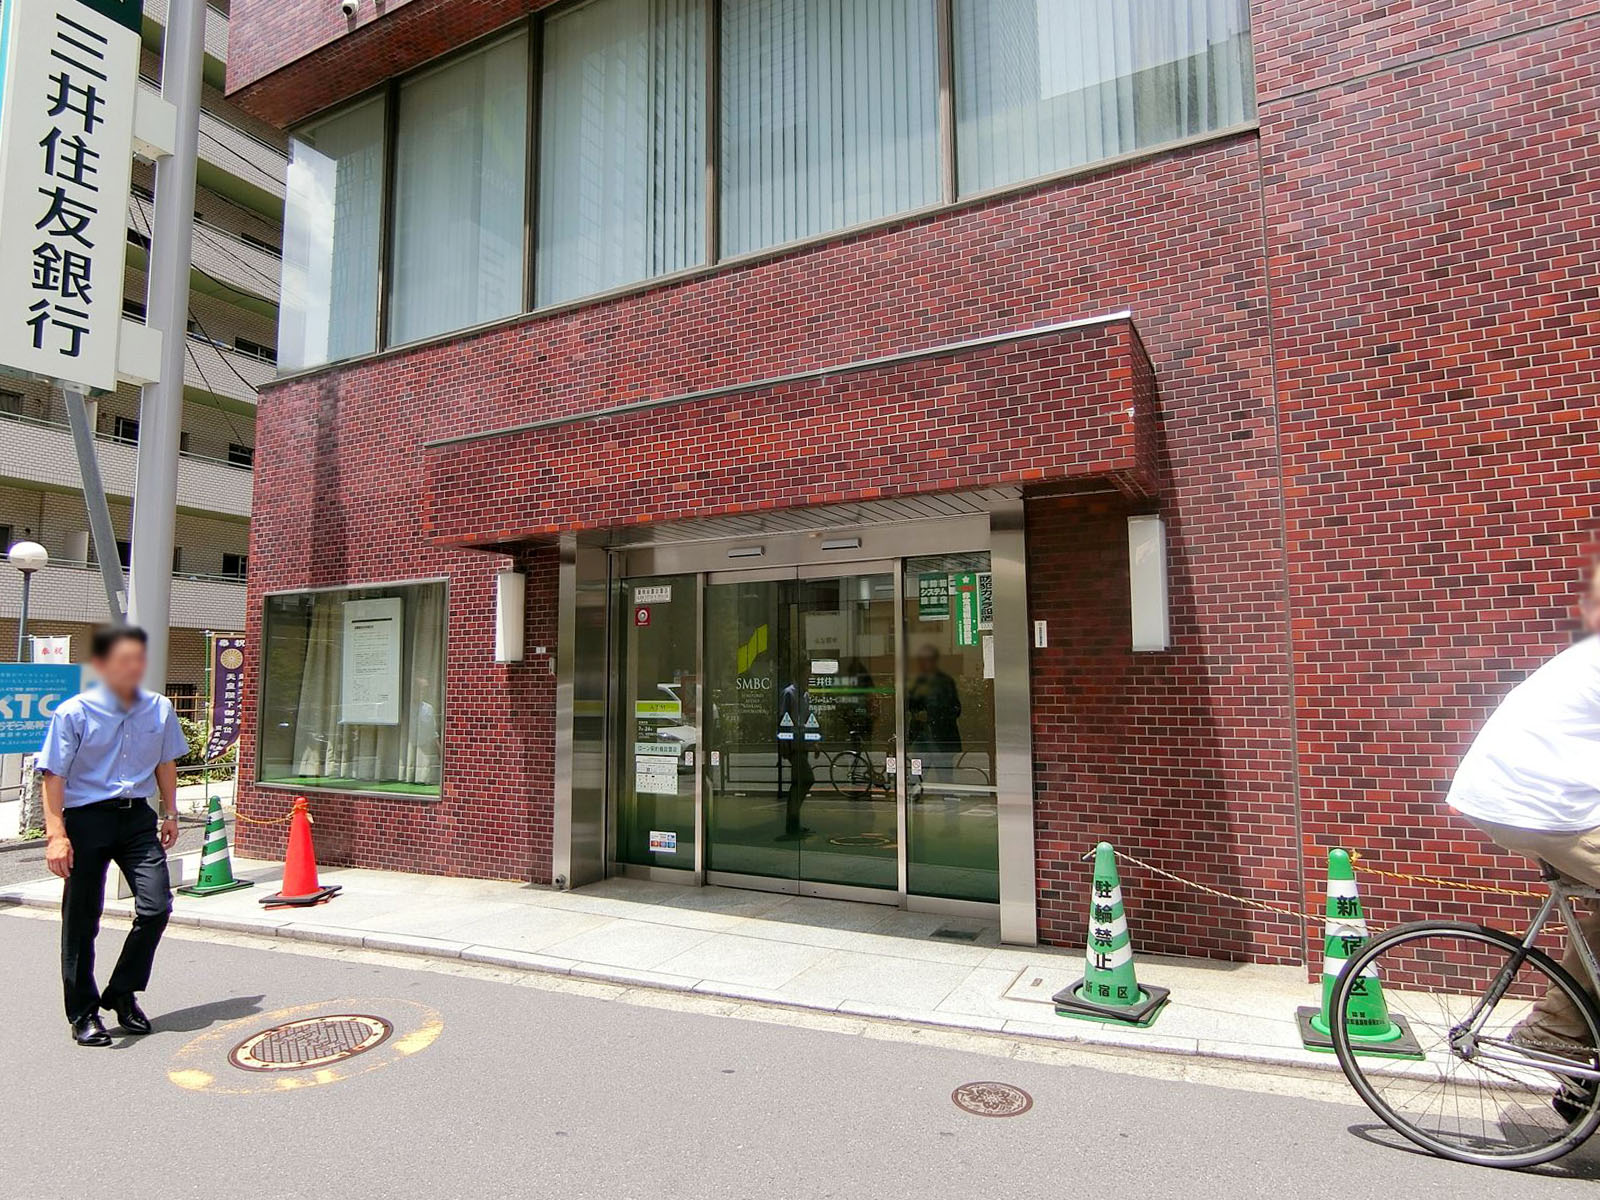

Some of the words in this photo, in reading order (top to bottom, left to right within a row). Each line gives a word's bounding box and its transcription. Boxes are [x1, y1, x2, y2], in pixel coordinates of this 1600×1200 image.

[26, 12, 108, 358] 三井住友銀行
[920, 587, 948, 597] システム
[735, 677, 771, 690] SMBC
[1094, 880, 1113, 972] 駐輪禁止
[1085, 980, 1128, 999] 新宿区
